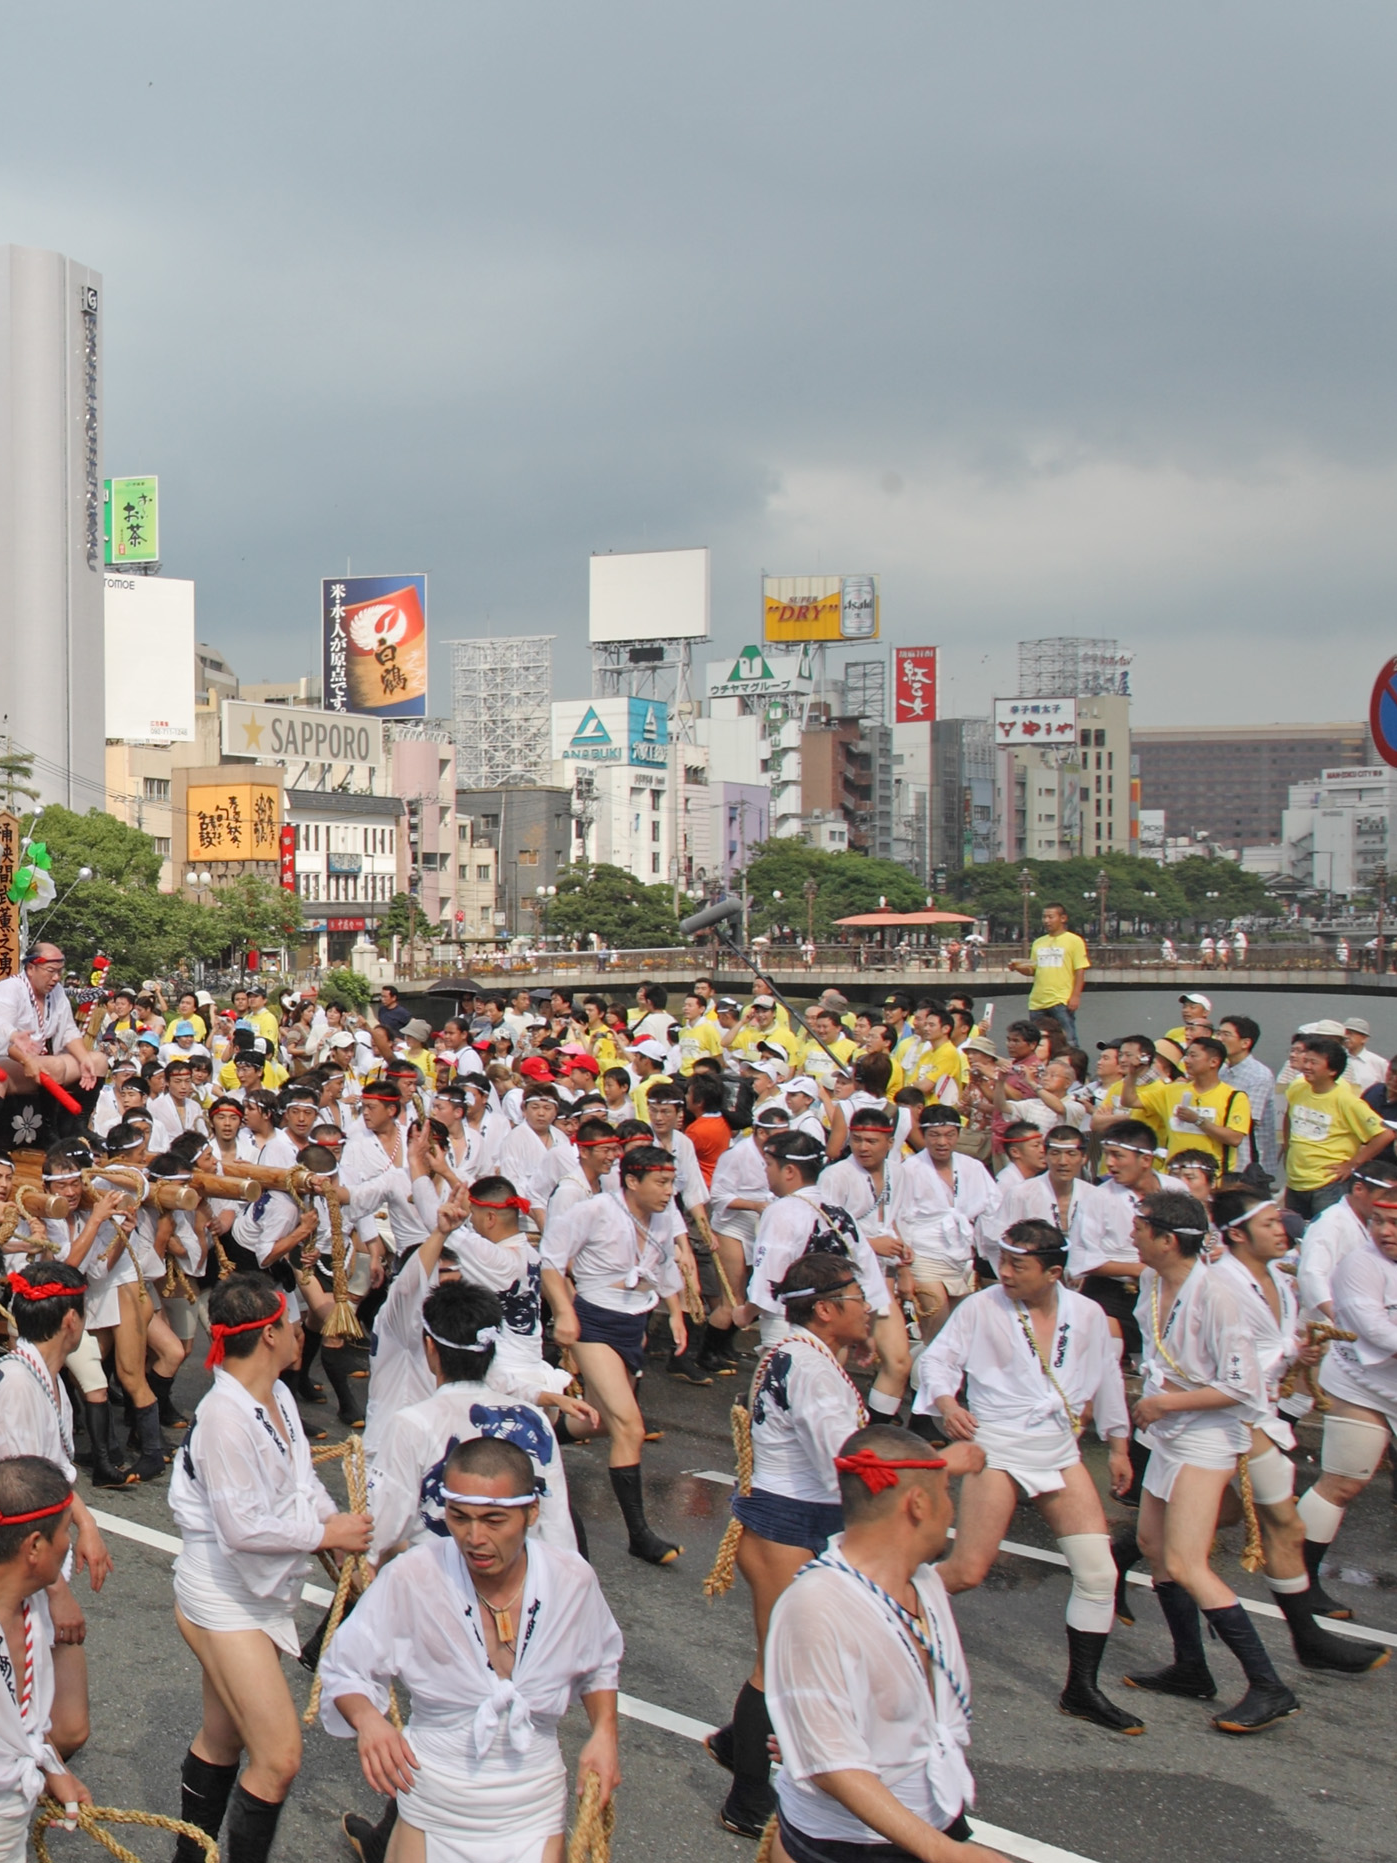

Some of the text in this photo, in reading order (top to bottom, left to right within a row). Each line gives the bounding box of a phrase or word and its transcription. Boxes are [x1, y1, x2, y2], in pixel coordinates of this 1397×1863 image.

[122, 501, 148, 548] お茶
[844, 598, 873, 611] Asahi
[329, 583, 348, 714] 米・水・人が原点です。
[374, 636, 408, 696] 白鶴
[710, 679, 792, 696] ウチヤマグループ
[898, 659, 933, 719] 紅乙女
[271, 717, 370, 761] SAPPORO
[563, 747, 623, 761] ANABUKI
